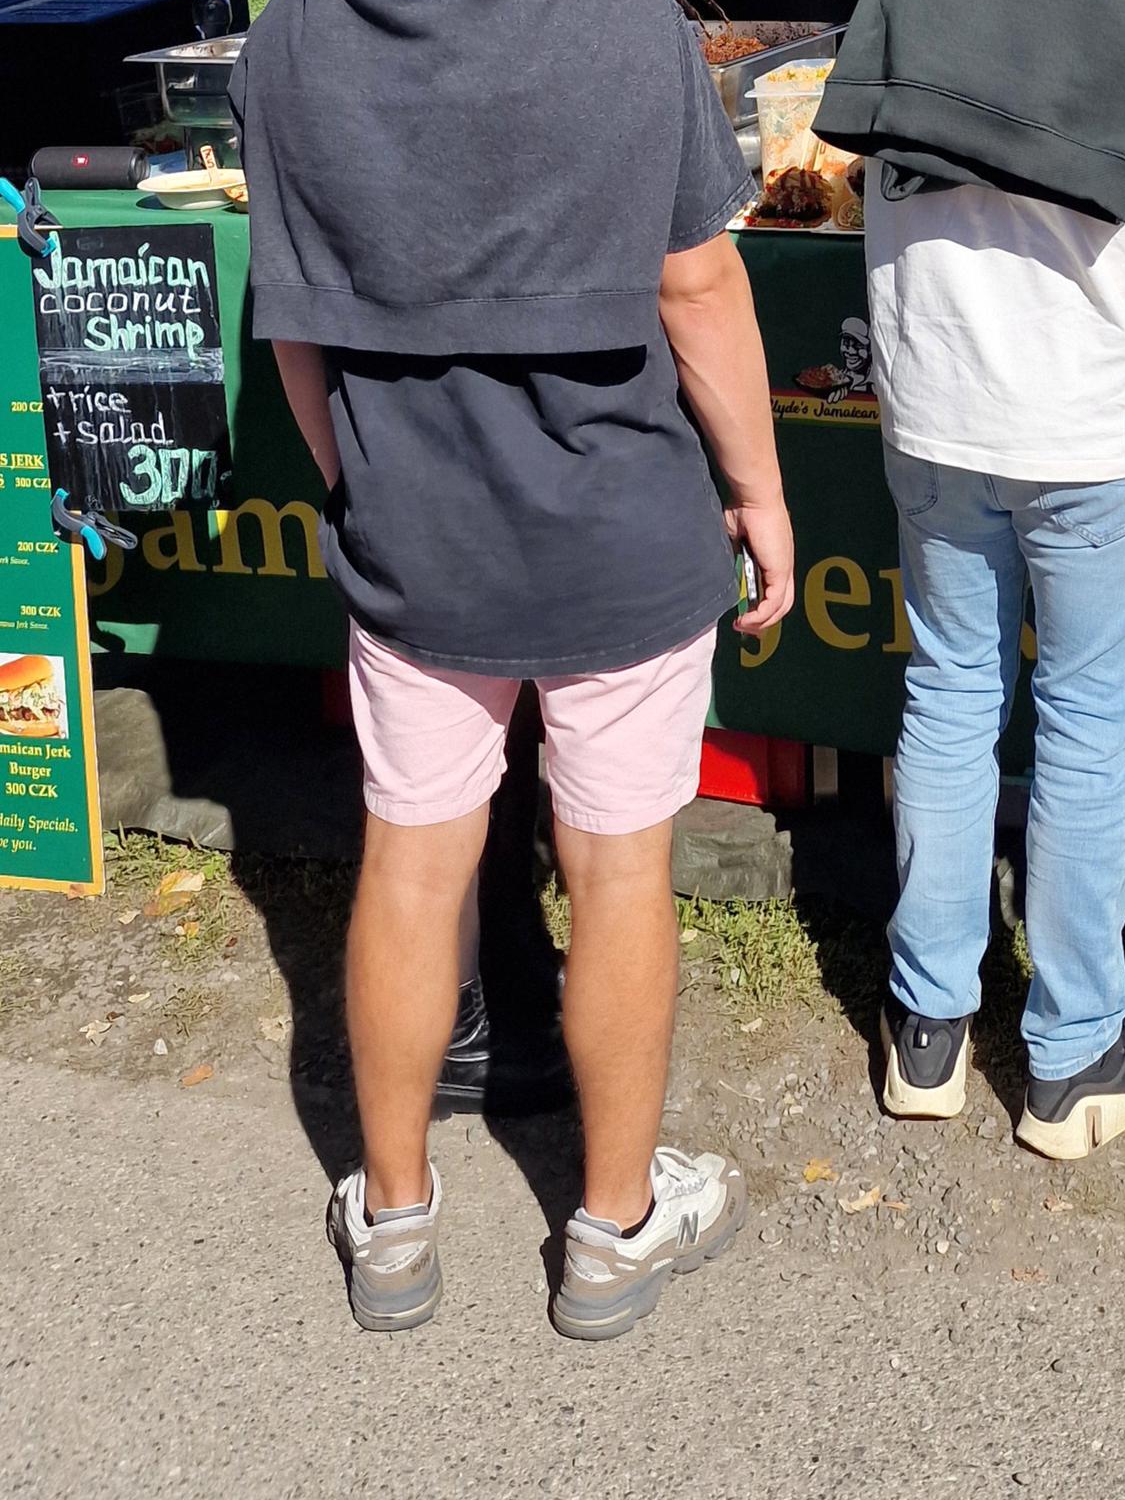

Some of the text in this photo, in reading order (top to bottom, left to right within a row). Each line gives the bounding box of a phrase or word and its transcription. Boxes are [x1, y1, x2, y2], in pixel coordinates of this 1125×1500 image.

[33, 230, 210, 290] Jamaican
[39, 290, 202, 316] coconut
[84, 314, 206, 361] Shrimp
[772, 398, 879, 420] lyde's Jamaican
[38, 605, 62, 618] CZK
[0, 741, 71, 760] maican Jerk
[9, 761, 52, 780] Burger
[5, 782, 59, 798] 300 CZK
[28, 815, 78, 834] Specials.
